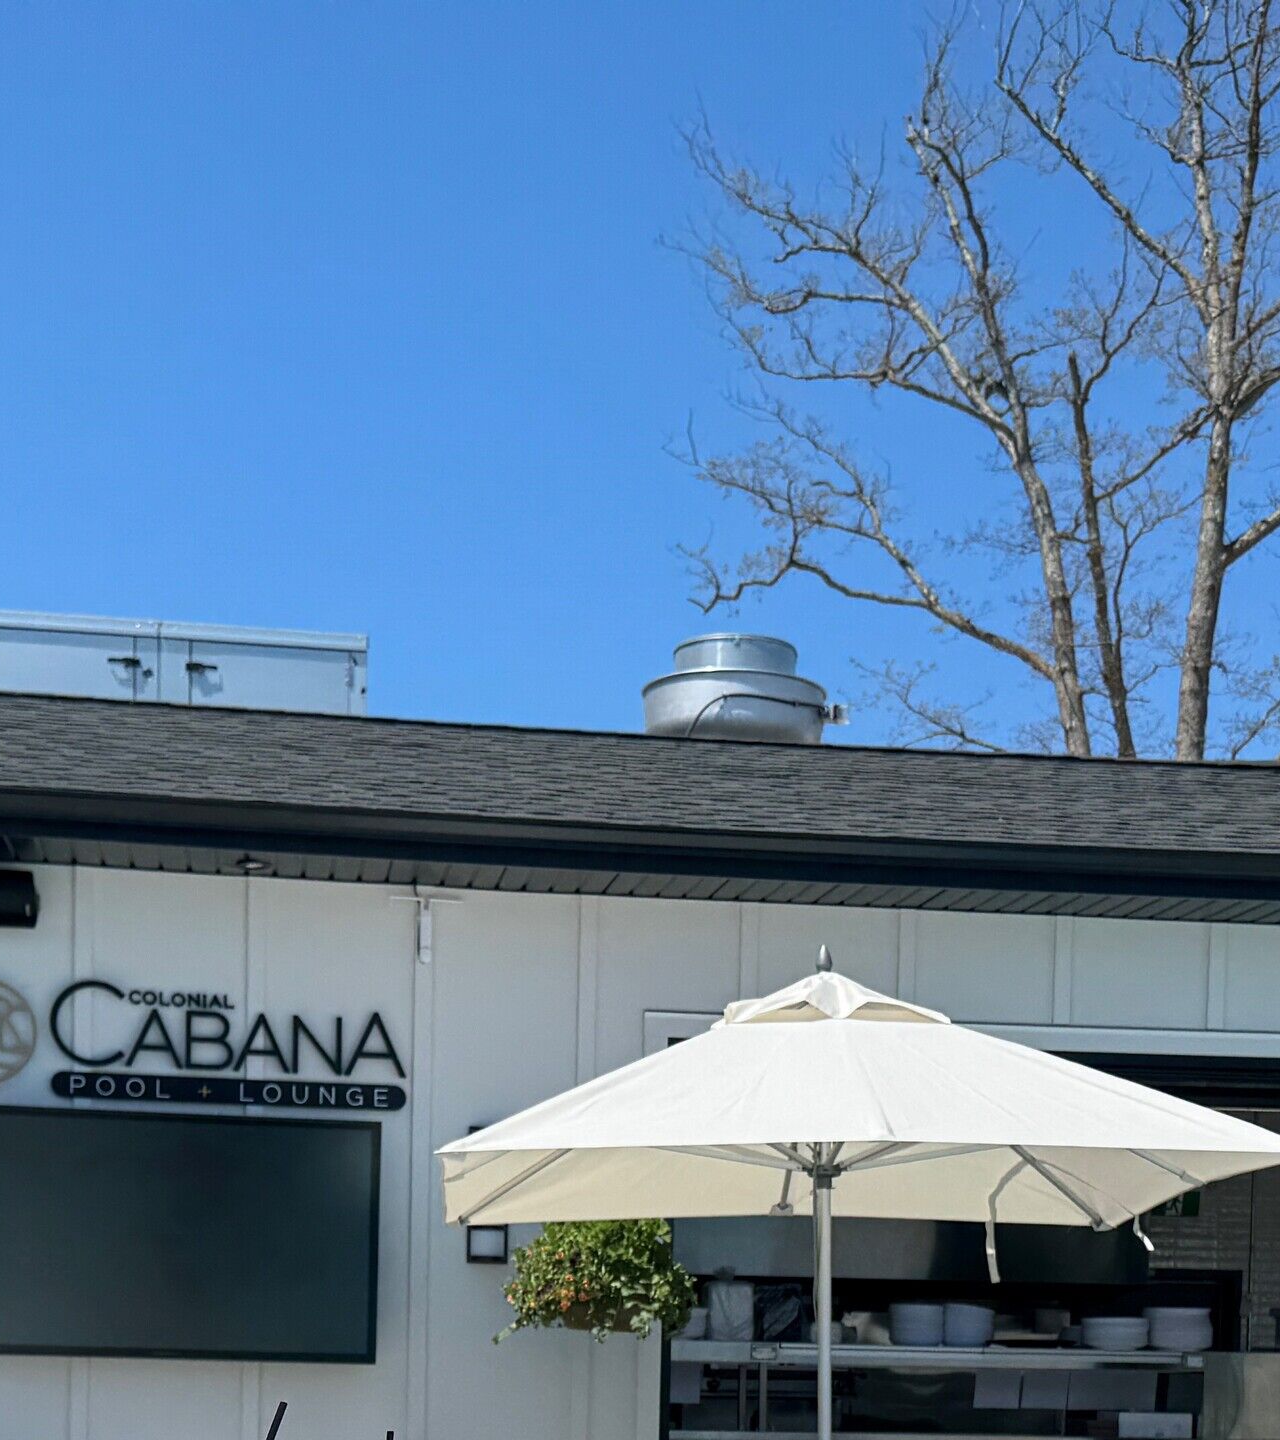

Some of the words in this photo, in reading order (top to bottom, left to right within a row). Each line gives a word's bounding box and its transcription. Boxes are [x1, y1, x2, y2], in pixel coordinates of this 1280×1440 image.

[128, 989, 234, 1010] COLONIAL
[48, 979, 407, 1078] CABANA
[69, 1076, 170, 1099] POOL
[239, 1083, 389, 1108] LOUNGE
